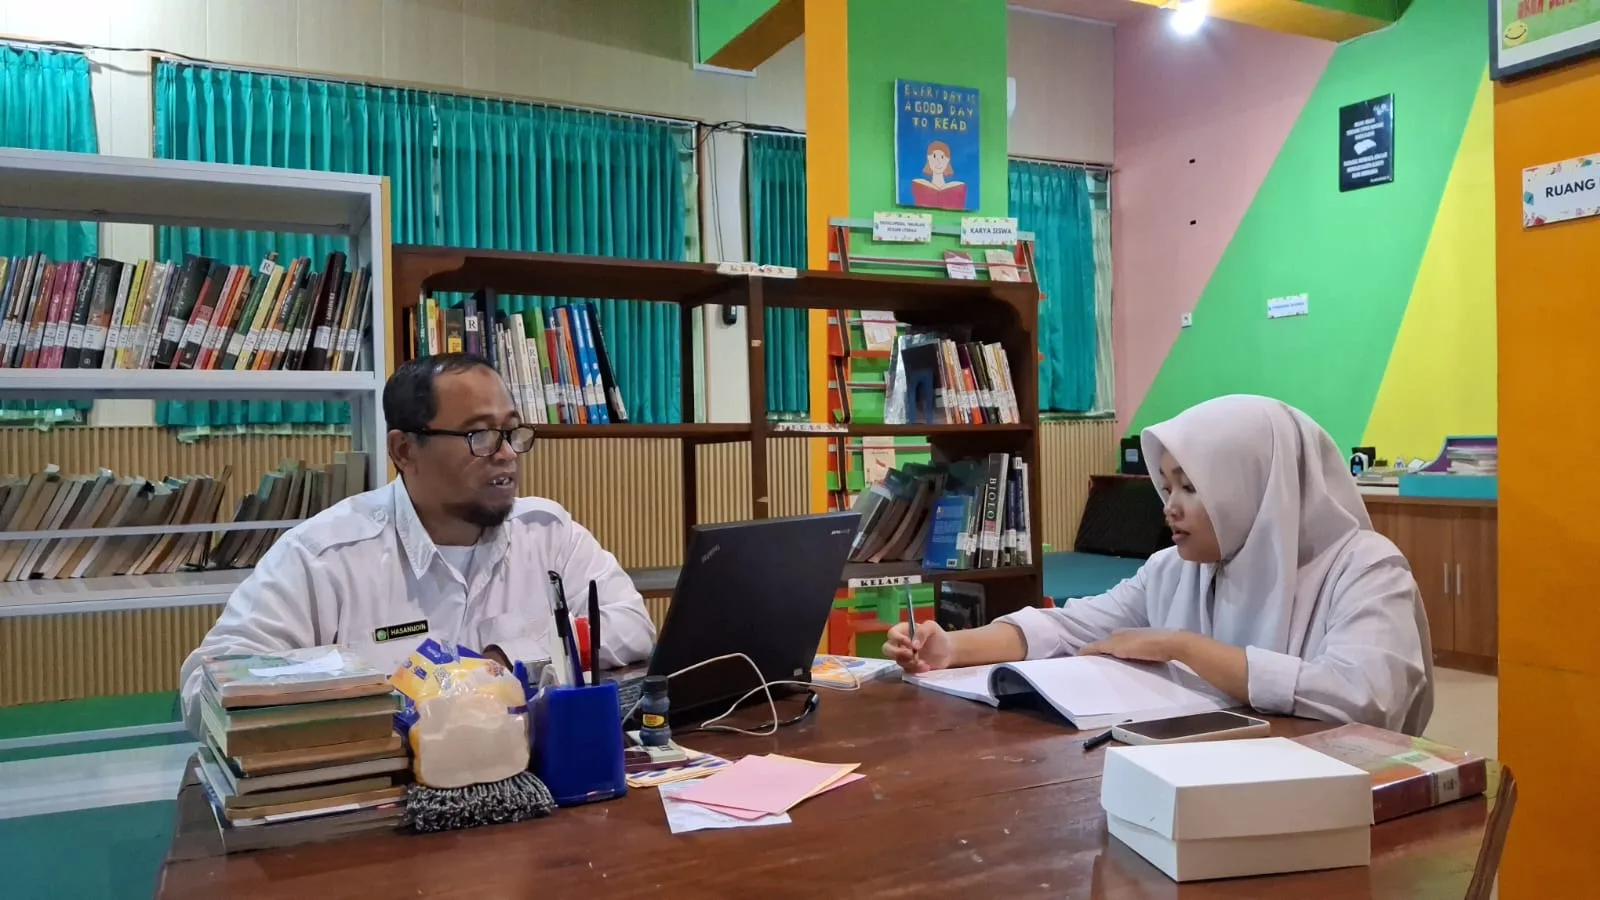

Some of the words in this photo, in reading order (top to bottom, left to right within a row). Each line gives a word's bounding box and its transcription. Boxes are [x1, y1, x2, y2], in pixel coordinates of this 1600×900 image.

[904, 101, 912, 111] A
[914, 101, 943, 115] GOOD
[950, 105, 974, 118] DAY
[912, 117, 928, 128] TO
[934, 117, 967, 131] READ
[1545, 178, 1596, 198] RUANG
[860, 577, 899, 587] KELAS
[390, 624, 426, 636] HASANUDIN
